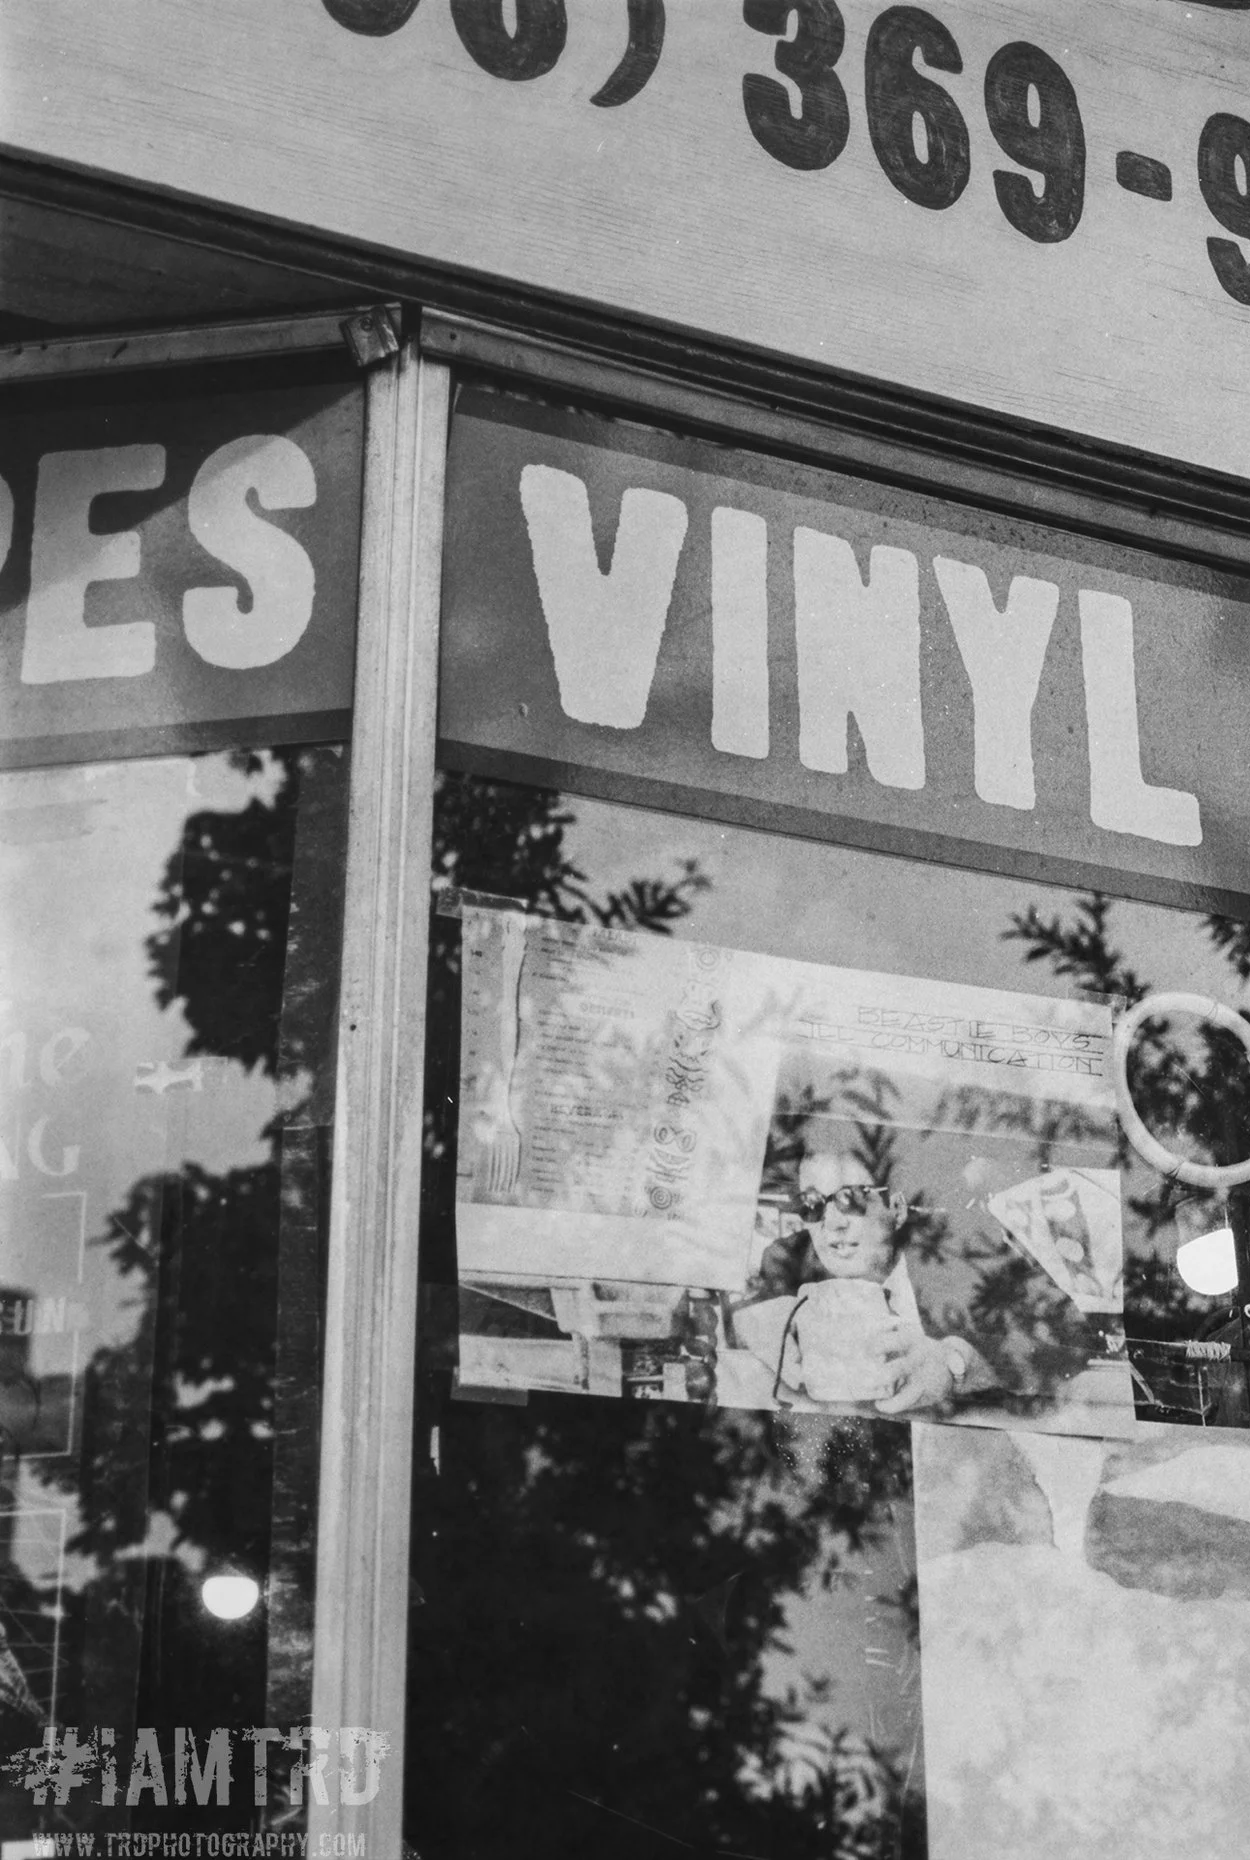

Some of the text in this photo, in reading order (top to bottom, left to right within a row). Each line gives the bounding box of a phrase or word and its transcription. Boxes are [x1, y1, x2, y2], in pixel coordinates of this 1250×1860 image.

[0, 433, 318, 685] ES
[519, 464, 1202, 846] VINYL
[857, 1006, 1092, 1052] BEASTIE BOYS
[871, 1031, 1095, 1076] COMMUNICATION
